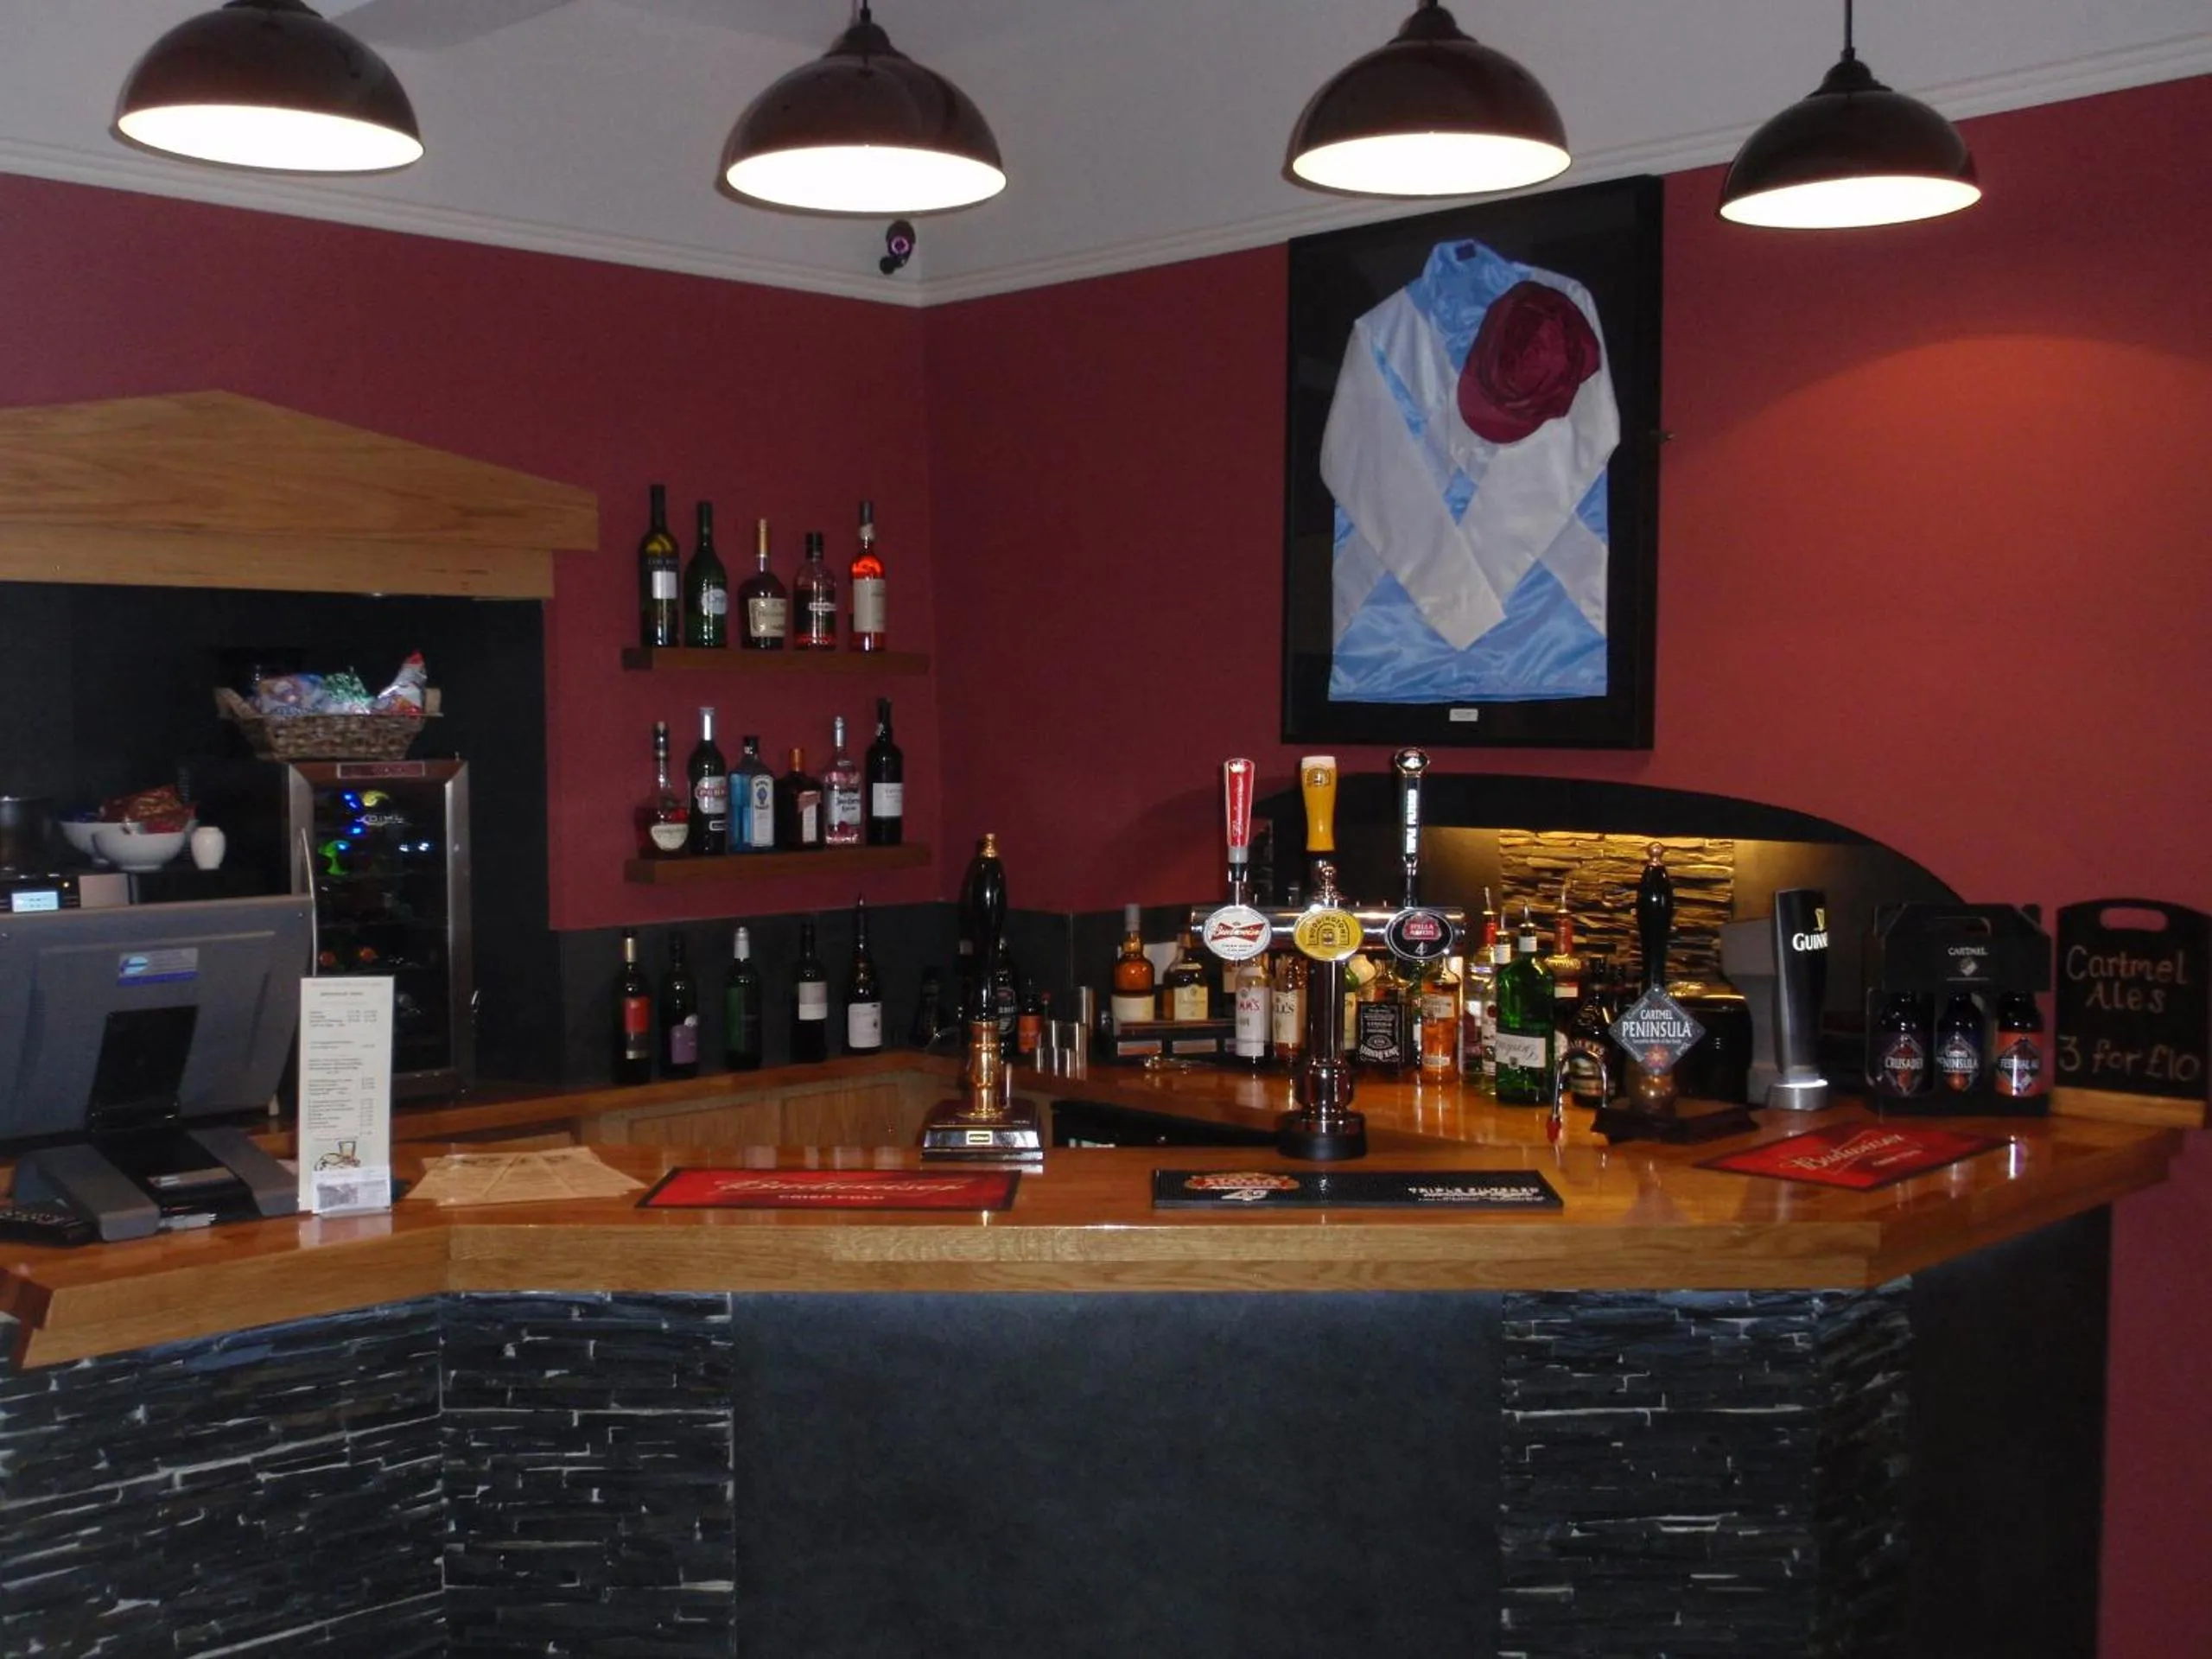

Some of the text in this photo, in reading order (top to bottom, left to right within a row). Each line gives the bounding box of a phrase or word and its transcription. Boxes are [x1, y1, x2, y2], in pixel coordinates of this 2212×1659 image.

[2066, 945, 2188, 985] Cartmel
[2086, 984, 2166, 1013] Ales
[1622, 1021, 1692, 1037] PENINSULA
[1640, 1009, 1674, 1020] CARTMEL
[2057, 1035, 2202, 1083] 3 for £10
